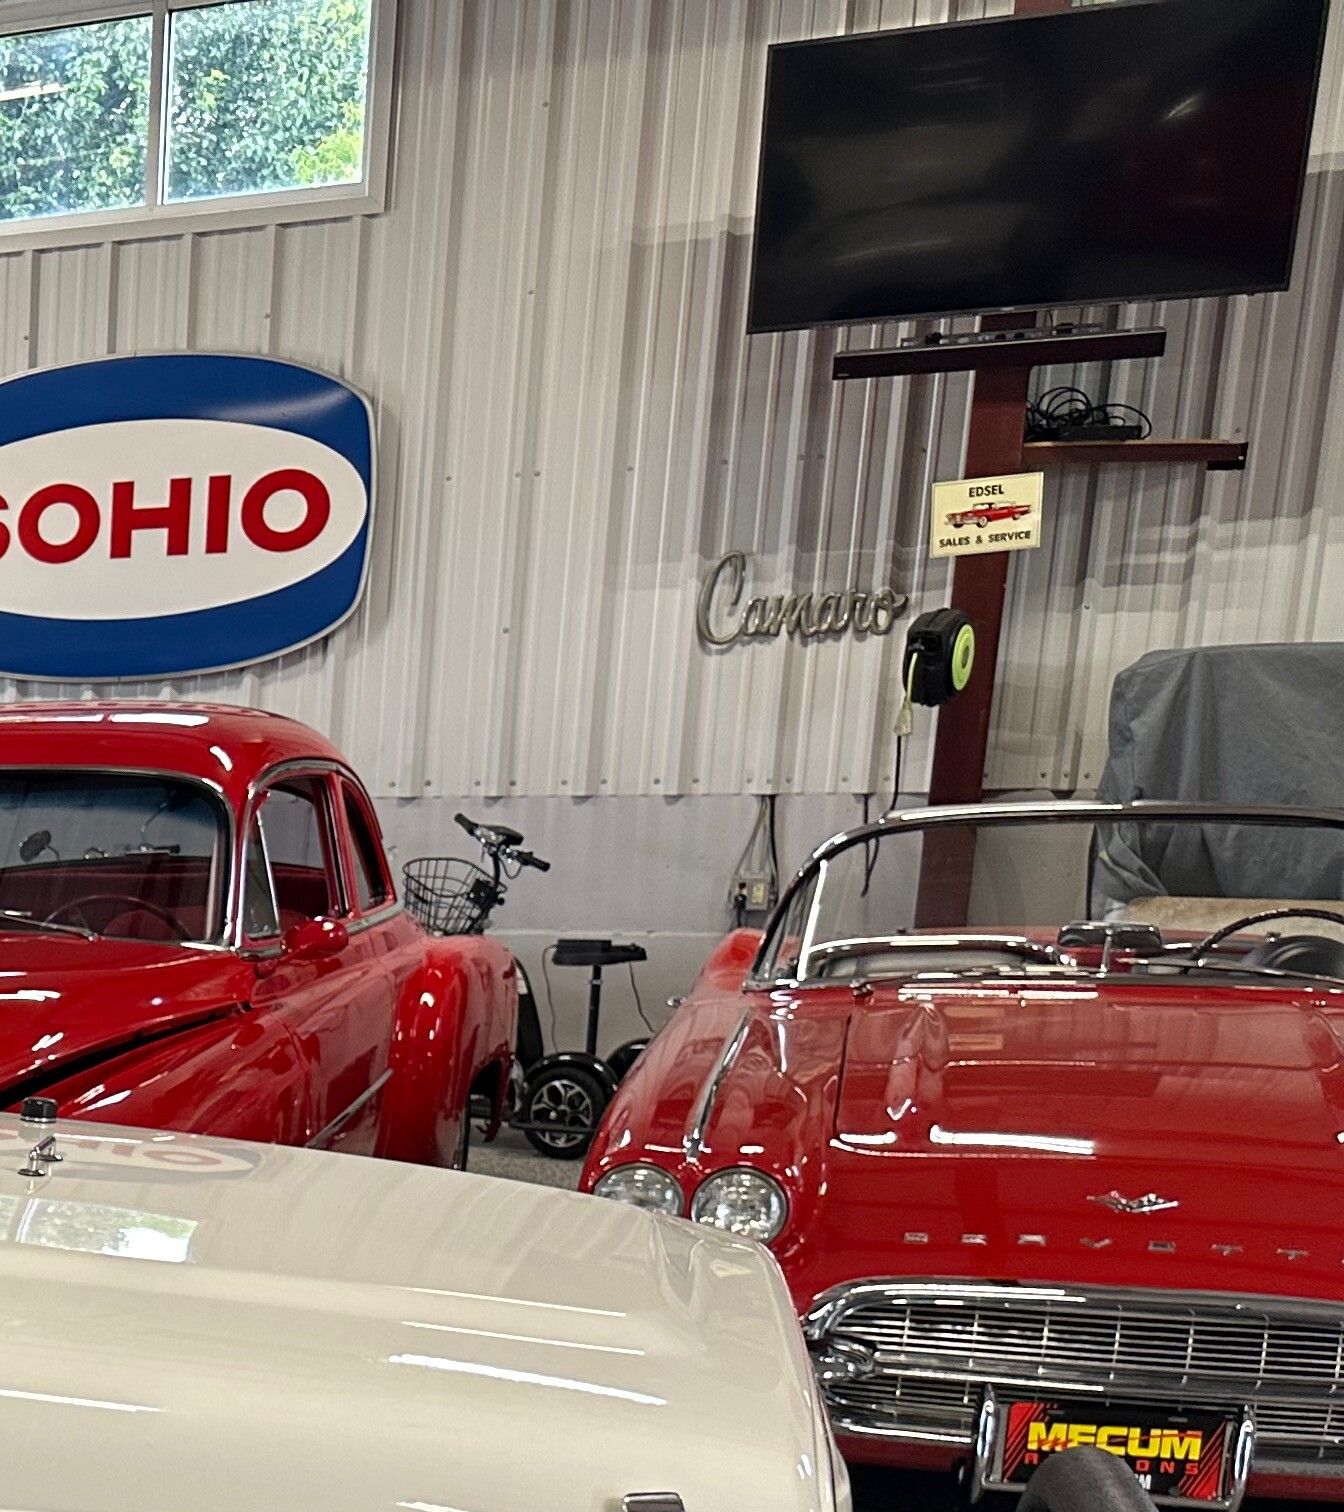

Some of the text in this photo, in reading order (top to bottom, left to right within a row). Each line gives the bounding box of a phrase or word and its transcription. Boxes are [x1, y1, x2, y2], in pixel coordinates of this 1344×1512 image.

[968, 484, 1005, 498] EDSEL
[939, 530, 1031, 548] SALES & SERVICE
[696, 550, 910, 646] Camaro
[1027, 1421, 1203, 1461] MECUM
